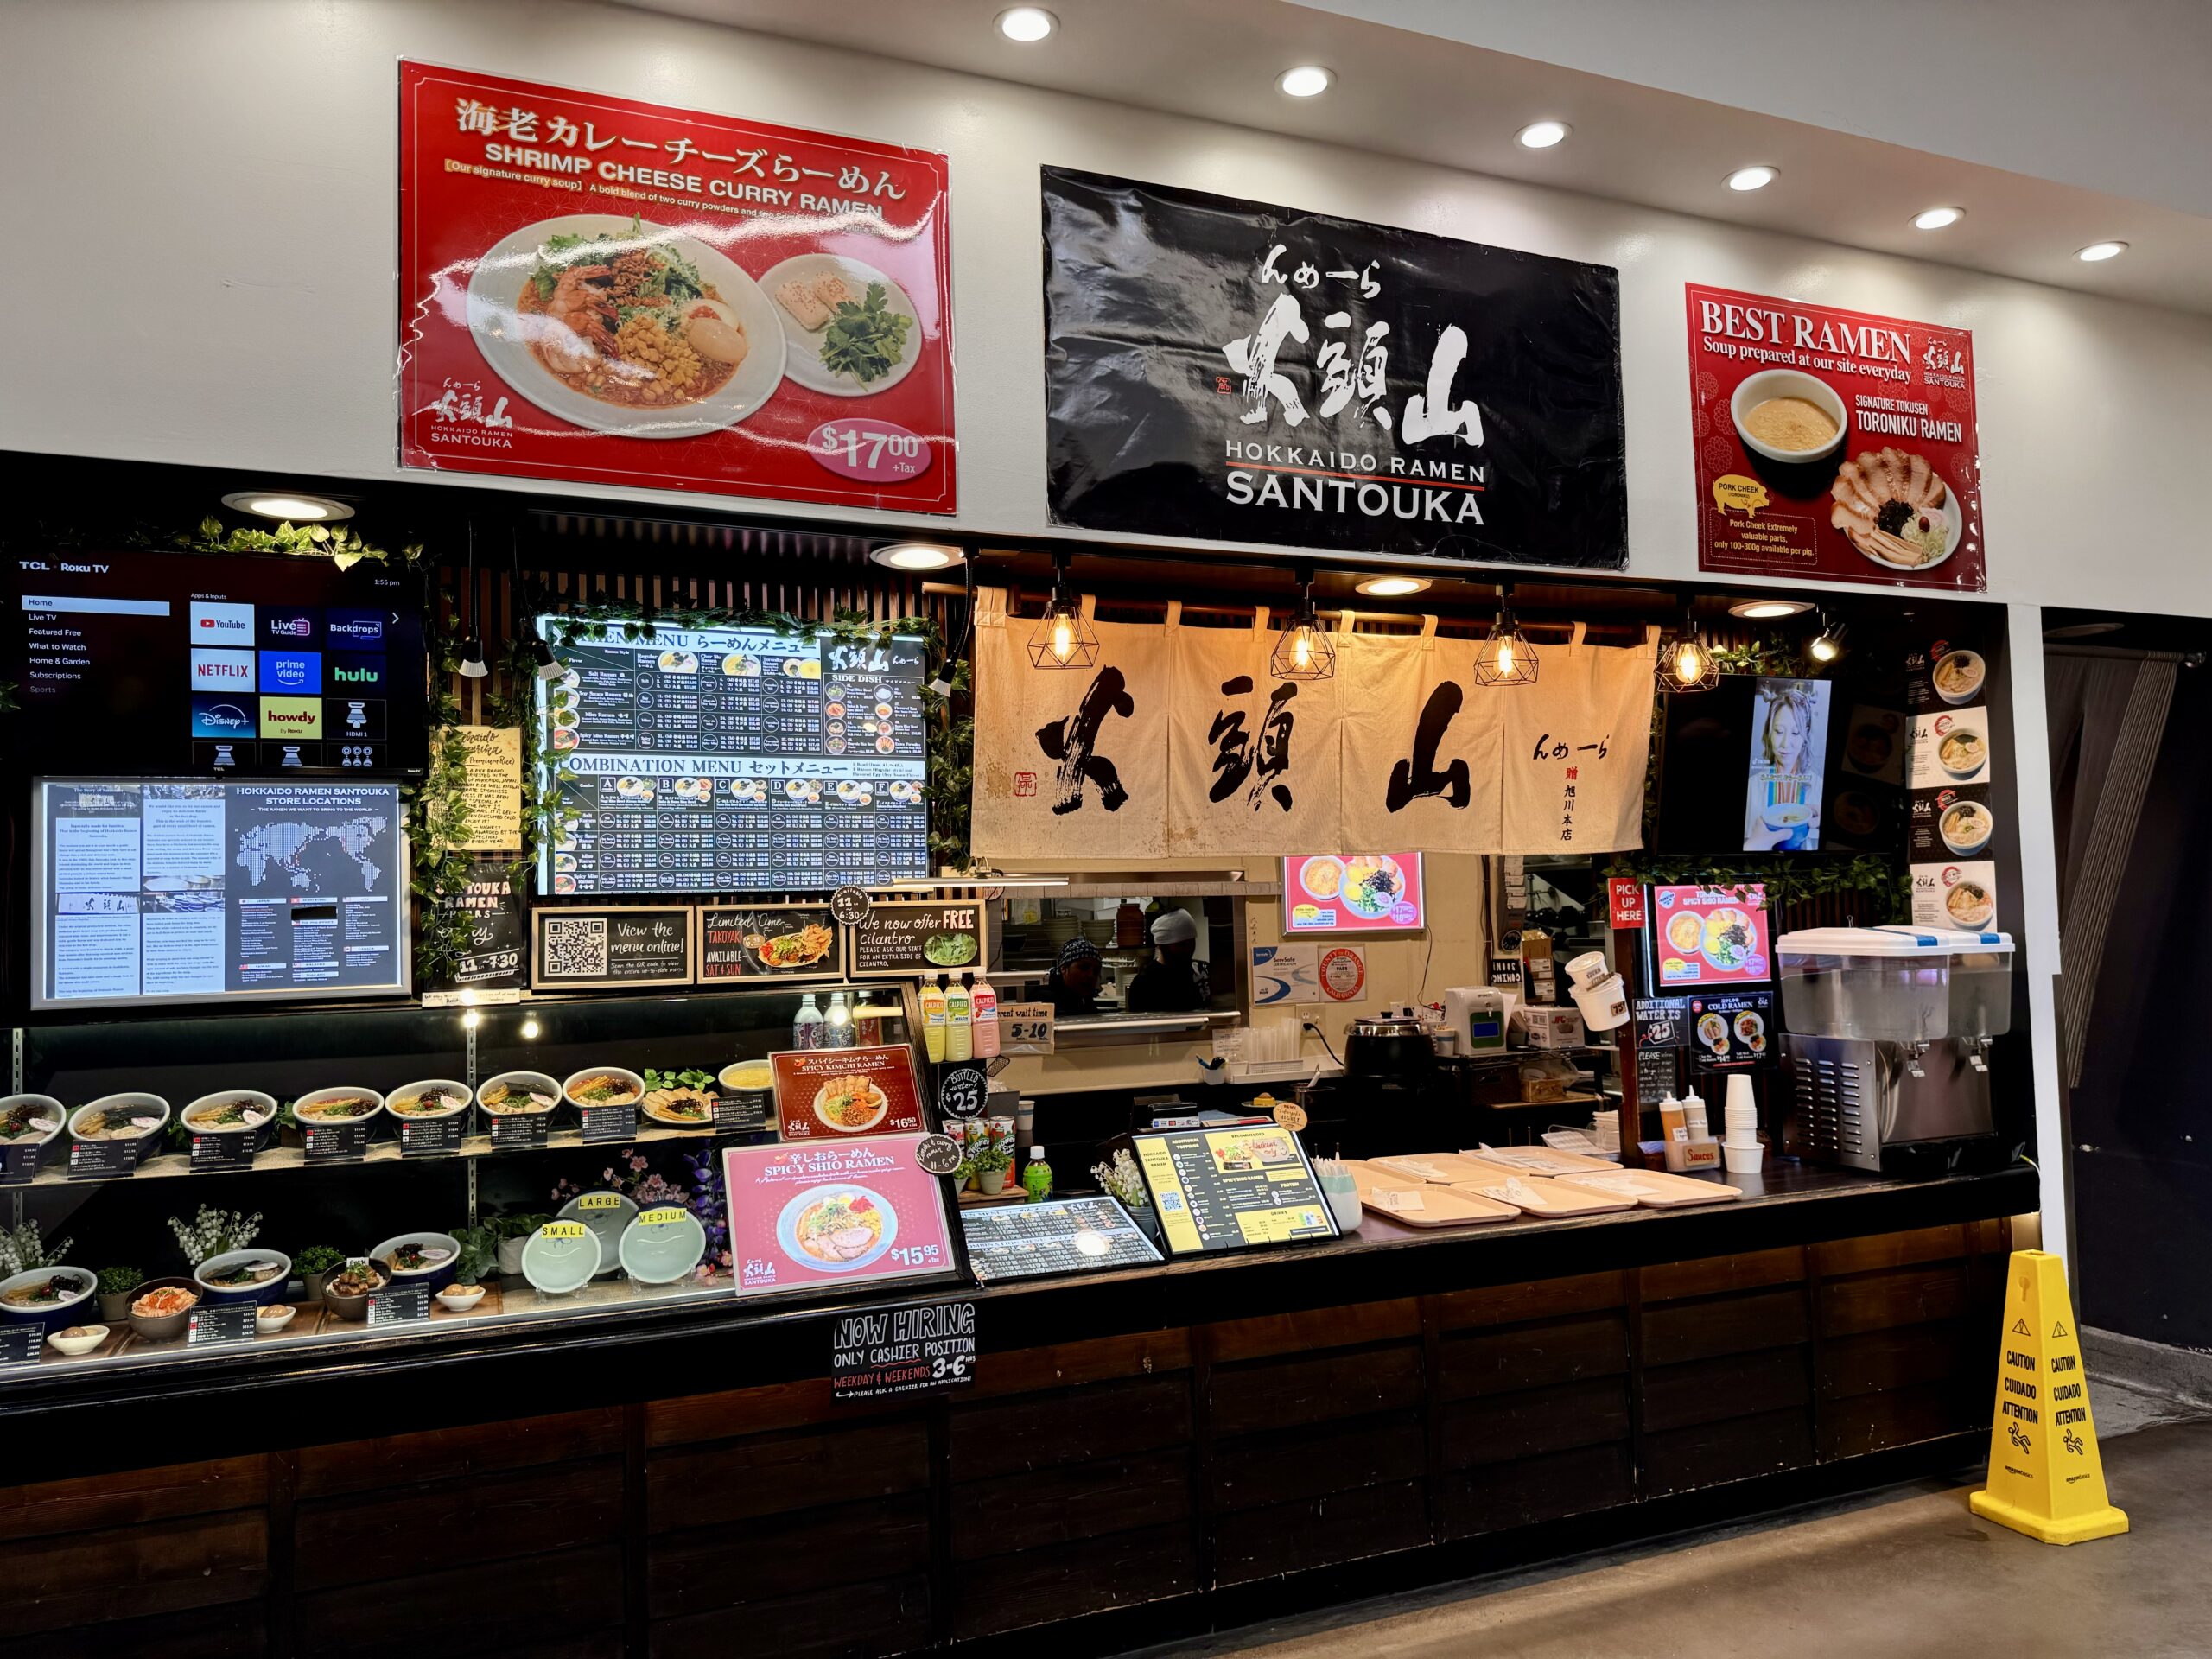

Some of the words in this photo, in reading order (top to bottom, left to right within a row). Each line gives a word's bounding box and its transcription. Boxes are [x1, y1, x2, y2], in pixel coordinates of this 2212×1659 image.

[456, 98, 906, 200] 海老カレーチーズらーめん
[474, 164, 521, 181] signature
[524, 175, 550, 188] curry
[485, 143, 592, 173] SHRIMP
[598, 162, 702, 194] CHEESE
[709, 179, 793, 206] CURRY
[800, 193, 883, 219] RAMEN
[599, 185, 619, 195] bold
[621, 188, 646, 200] blend
[648, 193, 658, 201] of
[659, 196, 676, 206] two
[677, 199, 700, 210] curry
[702, 202, 739, 213] powders
[741, 207, 757, 216] and
[1699, 300, 1786, 344] BEST
[1792, 315, 1912, 365] RAMEN
[1703, 336, 1737, 359] Soup
[1739, 345, 1796, 369] prepared
[1798, 353, 1811, 367] at
[1814, 358, 1834, 371] our
[1836, 358, 1857, 373] site
[1859, 365, 1912, 385] everyday
[1855, 395, 1895, 411] SIGNATURE
[1896, 400, 1929, 416] TOKUSEN
[1855, 410, 1917, 436] TORONIKU
[1920, 418, 1962, 443] RAMEN
[430, 433, 512, 448] SANTOUKA
[893, 462, 916, 474] +Tax
[1225, 440, 1377, 471] HOKKAIDO
[1390, 456, 1485, 484] RAMEN
[1719, 482, 1736, 493] PORK
[1738, 484, 1759, 493] CHEEK
[1226, 470, 1485, 526] SANTOUKA
[1729, 518, 1745, 529] Pork
[1745, 520, 1765, 531] Cheek
[1767, 522, 1798, 534] Extremely
[1741, 531, 1768, 541] valuable
[1770, 533, 1788, 544] parts,
[1714, 541, 1728, 550] only
[1730, 542, 1759, 553] 100-300g
[1761, 544, 1789, 554] available
[1790, 547, 1801, 556] per
[1802, 547, 1815, 557] pig.
[19, 561, 50, 570] TCL
[92, 564, 109, 574] TV
[216, 620, 245, 630] YouTube
[270, 620, 297, 631] Live
[330, 623, 379, 634] Backdrops
[698, 635, 817, 652] らーめんメニュー
[198, 664, 248, 678] NETFLIX
[276, 660, 305, 671] prime
[29, 671, 82, 680] Subscriptions
[276, 669, 305, 678] video
[334, 667, 378, 682] hulu
[268, 710, 315, 724] howdy
[692, 760, 742, 774] MENU
[749, 760, 848, 775] セットメニュー
[236, 787, 293, 796] HOKKAIDO
[1560, 785, 1576, 841] 旭川本店
[1616, 884, 1640, 895] PICK
[445, 896, 499, 908] RAMEN
[1622, 897, 1636, 908] UP
[706, 912, 754, 929] Limited
[859, 910, 880, 930] We
[884, 919, 912, 930] now
[913, 913, 942, 930] offer
[943, 909, 975, 930] FREE
[617, 922, 647, 937] View
[652, 921, 673, 937] the
[707, 930, 743, 944] TAKOYAKI
[610, 942, 645, 954] menu
[646, 938, 684, 954] online!
[705, 964, 719, 977] SAT
[726, 963, 741, 976] SUN
[1636, 998, 1686, 1010] ADDITIONAL
[1728, 1001, 1753, 1009] RAMEN
[1016, 1008, 1031, 1017] wait
[1032, 1007, 1048, 1017] time
[1636, 1009, 1667, 1021] WATER
[1668, 1009, 1681, 1020] IS
[1011, 1022, 1048, 1039] 5-10
[808, 1053, 890, 1065] スパイシーキムチらーめん
[825, 1062, 855, 1071] KIMCHI
[856, 1060, 886, 1070] RAMEN
[950, 1069, 979, 1082] BOTTLED
[790, 1147, 875, 1163] 辛しおらーめん
[1687, 1148, 1715, 1163] Sauces
[764, 1164, 805, 1177] SPICY
[808, 1160, 842, 1173] SHIO
[845, 1155, 895, 1170] RAMEN
[579, 1197, 620, 1207] LARGE
[639, 1211, 686, 1224] MEDIUM
[542, 1226, 584, 1236] SMALL
[833, 1313, 889, 1350] NOW
[893, 1303, 976, 1342] HIRING
[834, 1350, 865, 1368] ONLY
[870, 1344, 920, 1363] CASHIER
[925, 1338, 976, 1357] POSITION
[2006, 1350, 2036, 1372] CAUTION
[2050, 1355, 2076, 1374] CAUTION
[834, 1373, 874, 1389] WEEKDAY
[884, 1366, 931, 1382] WEEKENDS
[2004, 1376, 2037, 1400] CUIDADO
[2053, 1382, 2082, 1401] CUIDADO
[2002, 1401, 2038, 1425] ATTENTION
[2055, 1407, 2086, 1427] ATTENTION
